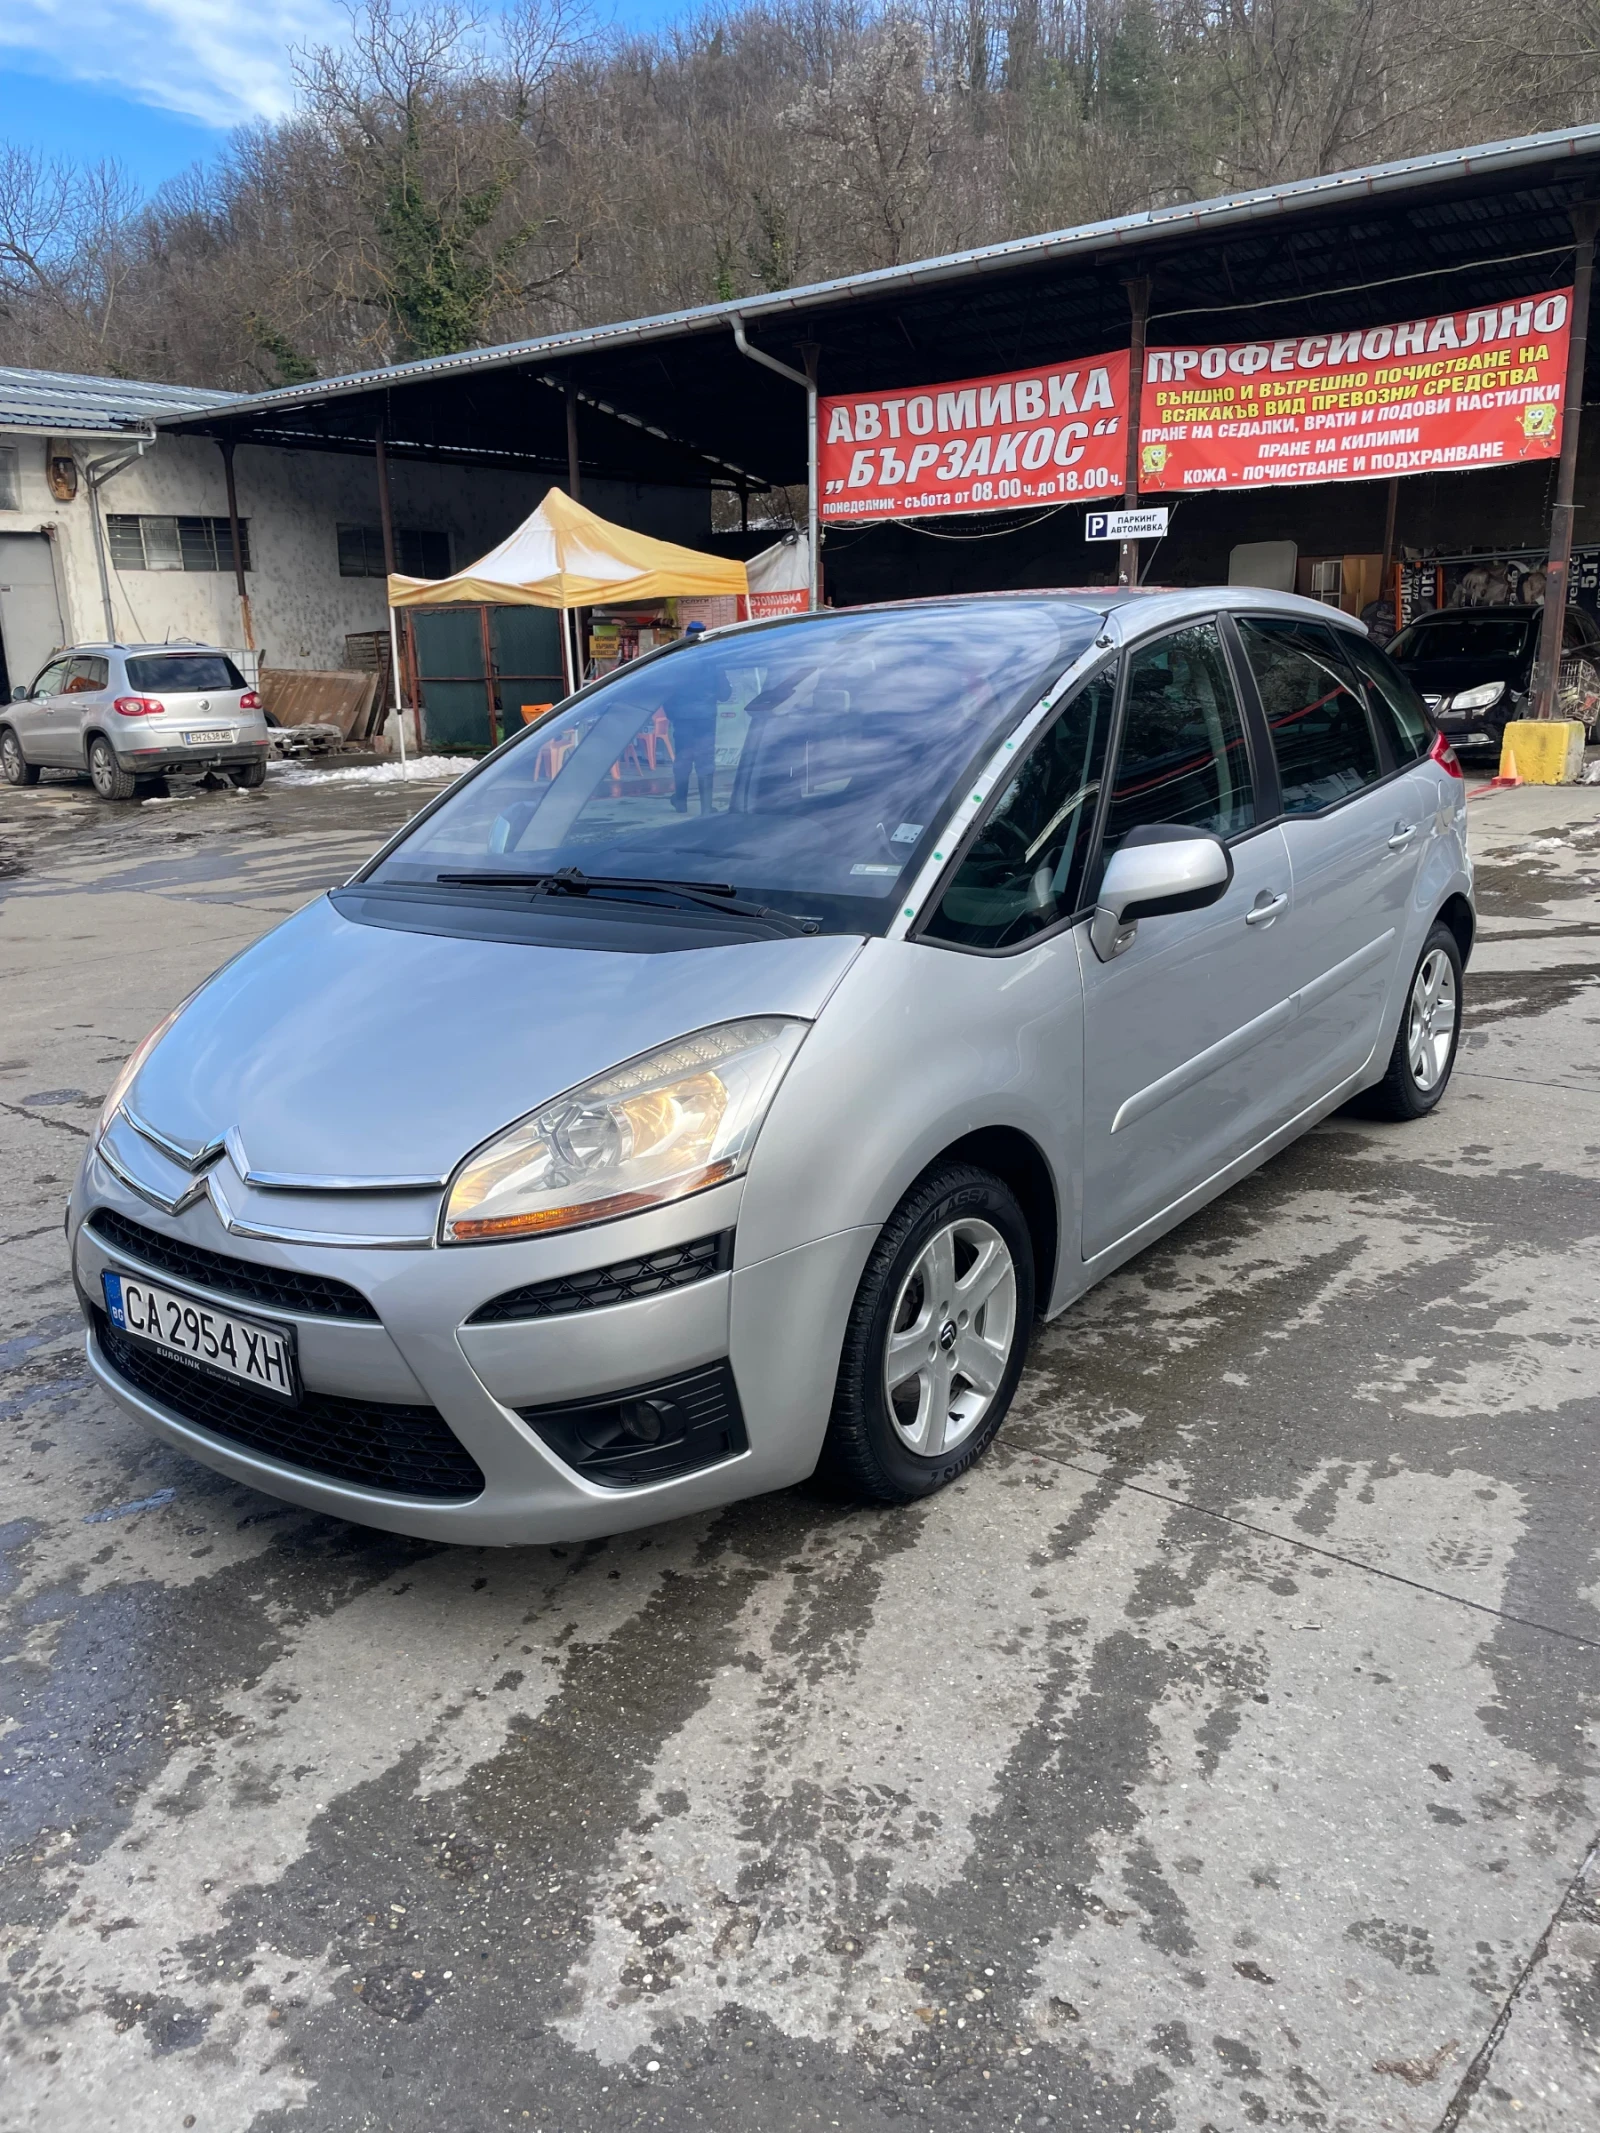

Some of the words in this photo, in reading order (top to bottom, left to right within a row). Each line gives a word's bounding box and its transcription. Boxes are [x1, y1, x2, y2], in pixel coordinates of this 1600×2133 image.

[1147, 295, 1568, 383] ПРОФЕСИОНАЛНО
[1156, 387, 1235, 407] ВЪНШНО
[1240, 384, 1254, 400] И
[1259, 372, 1368, 398] ВЪТРЕШНО
[1374, 349, 1512, 385] ПОЧИСТВАНЕ
[1518, 344, 1549, 364] НА
[826, 367, 1116, 444] АВТОМИВКА
[1161, 403, 1259, 424] ВСЯКАКЪВ
[1265, 397, 1306, 417] ВИД
[1312, 384, 1418, 411] ПРЕВОЗНИ
[1423, 366, 1539, 396] СРЕДСТВА
[1141, 425, 1188, 443] ПРАНЕ
[1192, 425, 1213, 439] НА
[1218, 418, 1299, 438] СЕДАЛКИ,
[1304, 411, 1357, 431] ВРАТИ
[1360, 409, 1373, 424] И
[1377, 398, 1451, 422] ПОДОВИ
[1455, 384, 1560, 412] НАСТИЛКИ
[1258, 440, 1311, 459] ПРАНЕ
[1315, 437, 1336, 454] НА
[1340, 427, 1420, 450] КИЛИМИ
[1183, 467, 1227, 485] КОЖА
[1242, 457, 1349, 481] ПОЧИСТВАНЕ
[1353, 456, 1366, 472] И
[1370, 441, 1504, 470] ПОДХРАНВАНЕ
[822, 497, 895, 515] понеделник
[904, 492, 951, 509] събота
[954, 491, 970, 504] от
[971, 477, 1022, 501] 08.00
[1023, 483, 1036, 497] ч.
[1037, 482, 1056, 498] до
[1056, 467, 1109, 492] 18.00
[1110, 473, 1123, 487] ч.
[1092, 517, 1105, 536] P
[1110, 523, 1163, 534] АВТОМИВКА
[1117, 514, 1157, 524] ПАРКИНГ
[745, 593, 802, 606] ВТОМИВКА
[752, 606, 798, 618] ЪРЗАКОС
[202, 733, 220, 741] 2638
[111, 1306, 124, 1322] BG
[126, 1285, 164, 1339] CA
[166, 1301, 237, 1369] 2954
[241, 1326, 286, 1387] XH
[156, 1347, 200, 1370] EUROLINK
